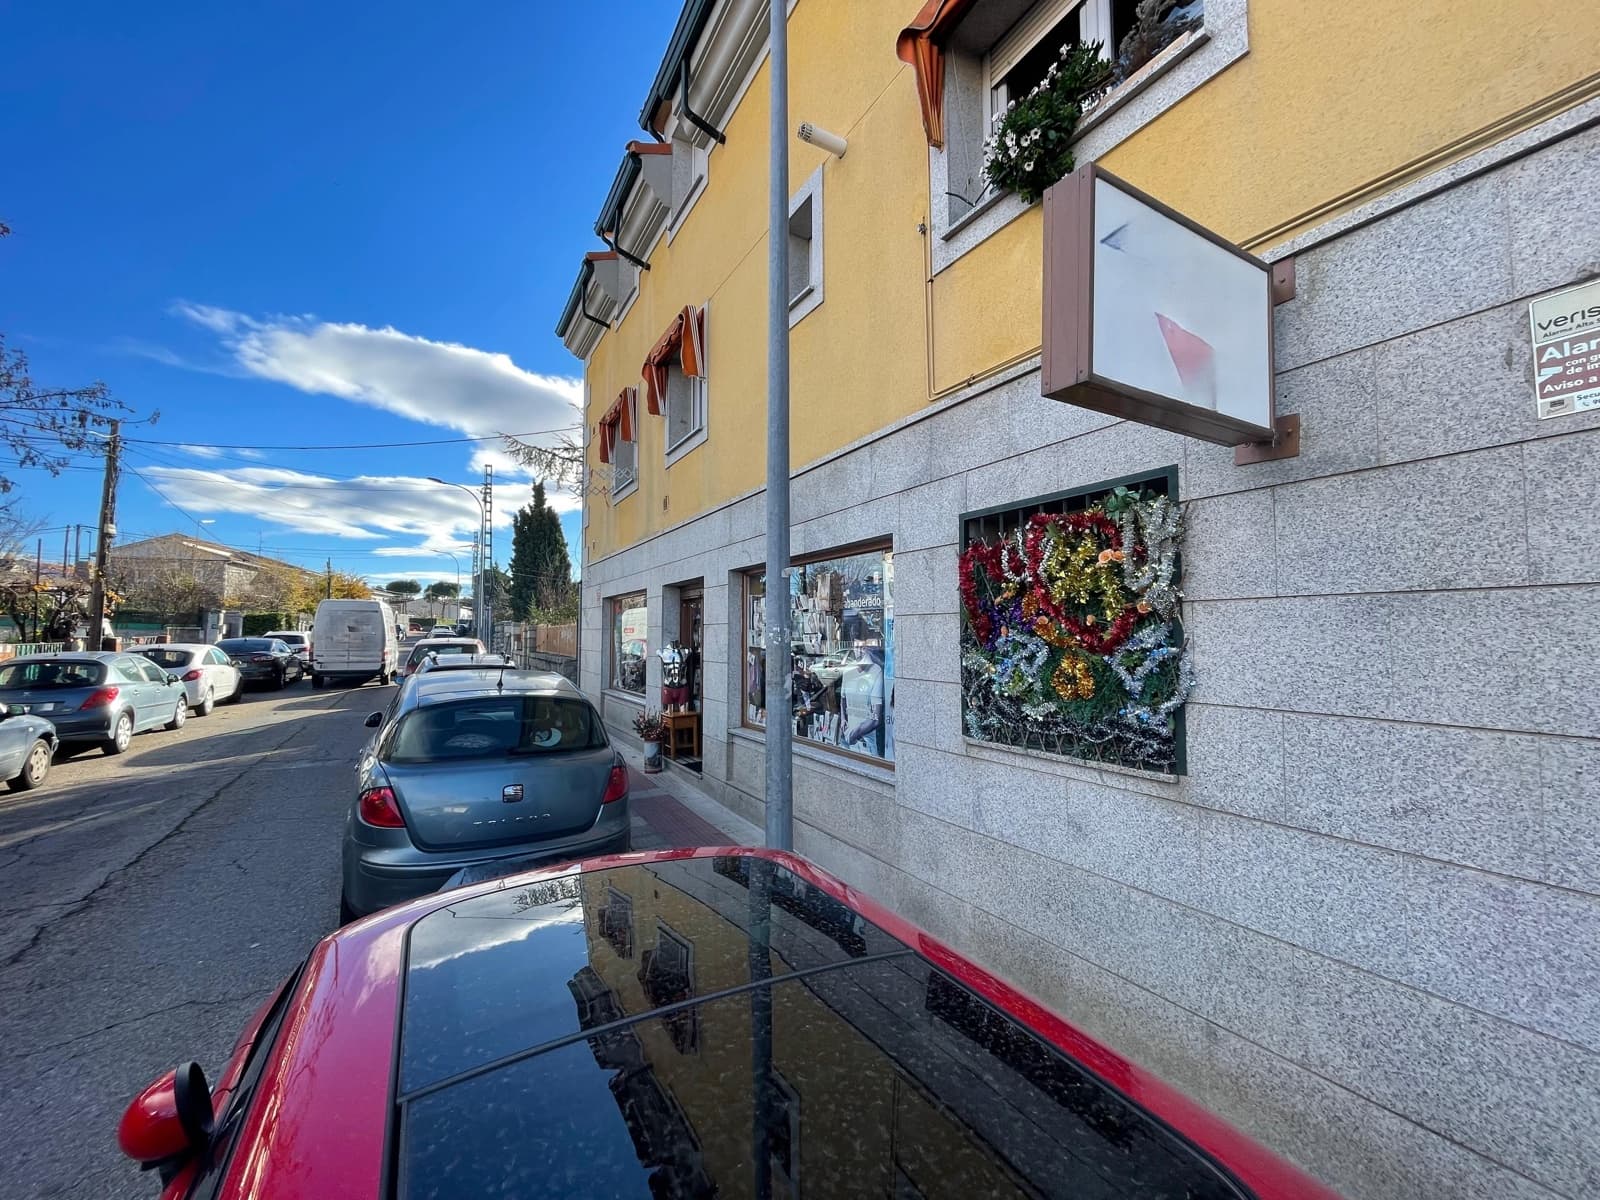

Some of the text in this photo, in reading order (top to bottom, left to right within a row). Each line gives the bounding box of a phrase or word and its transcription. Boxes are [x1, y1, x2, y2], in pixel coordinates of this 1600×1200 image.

[1537, 306, 1600, 330] veris
[1540, 338, 1600, 363] Alar
[1565, 357, 1586, 367] con
[1566, 366, 1583, 375] de
[1543, 379, 1584, 393] Aviso
